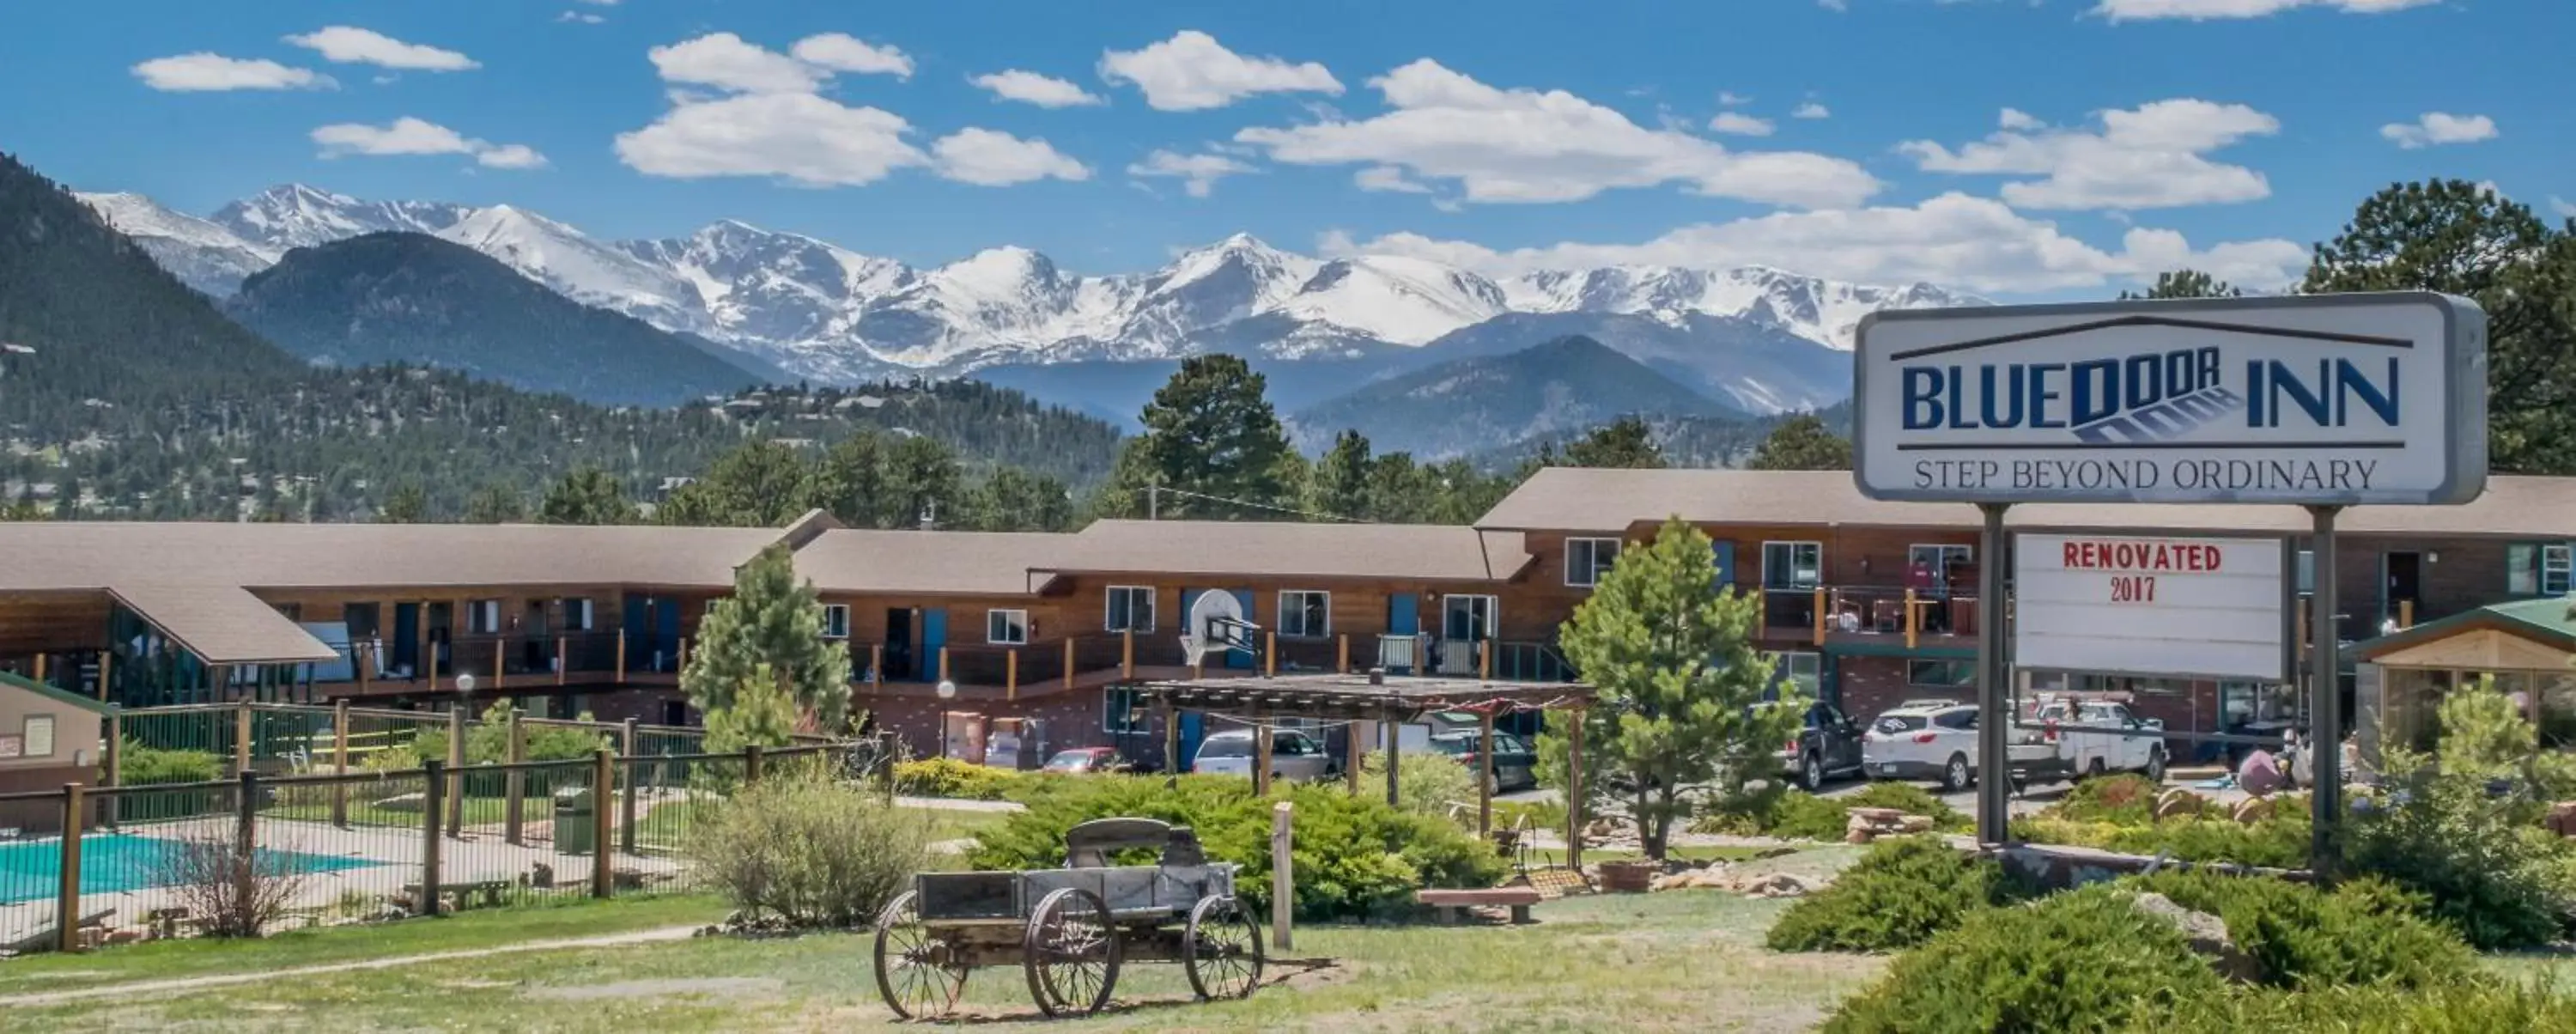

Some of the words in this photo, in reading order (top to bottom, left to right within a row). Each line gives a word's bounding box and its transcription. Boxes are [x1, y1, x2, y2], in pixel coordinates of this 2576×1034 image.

[2246, 356, 2399, 428] INN
[1914, 459, 1999, 490] STEP
[2012, 459, 2160, 490] BEYOND
[2172, 459, 2378, 490] ORDINARY
[2063, 541, 2222, 572] RENOVATED
[2110, 575, 2155, 602] 2017
